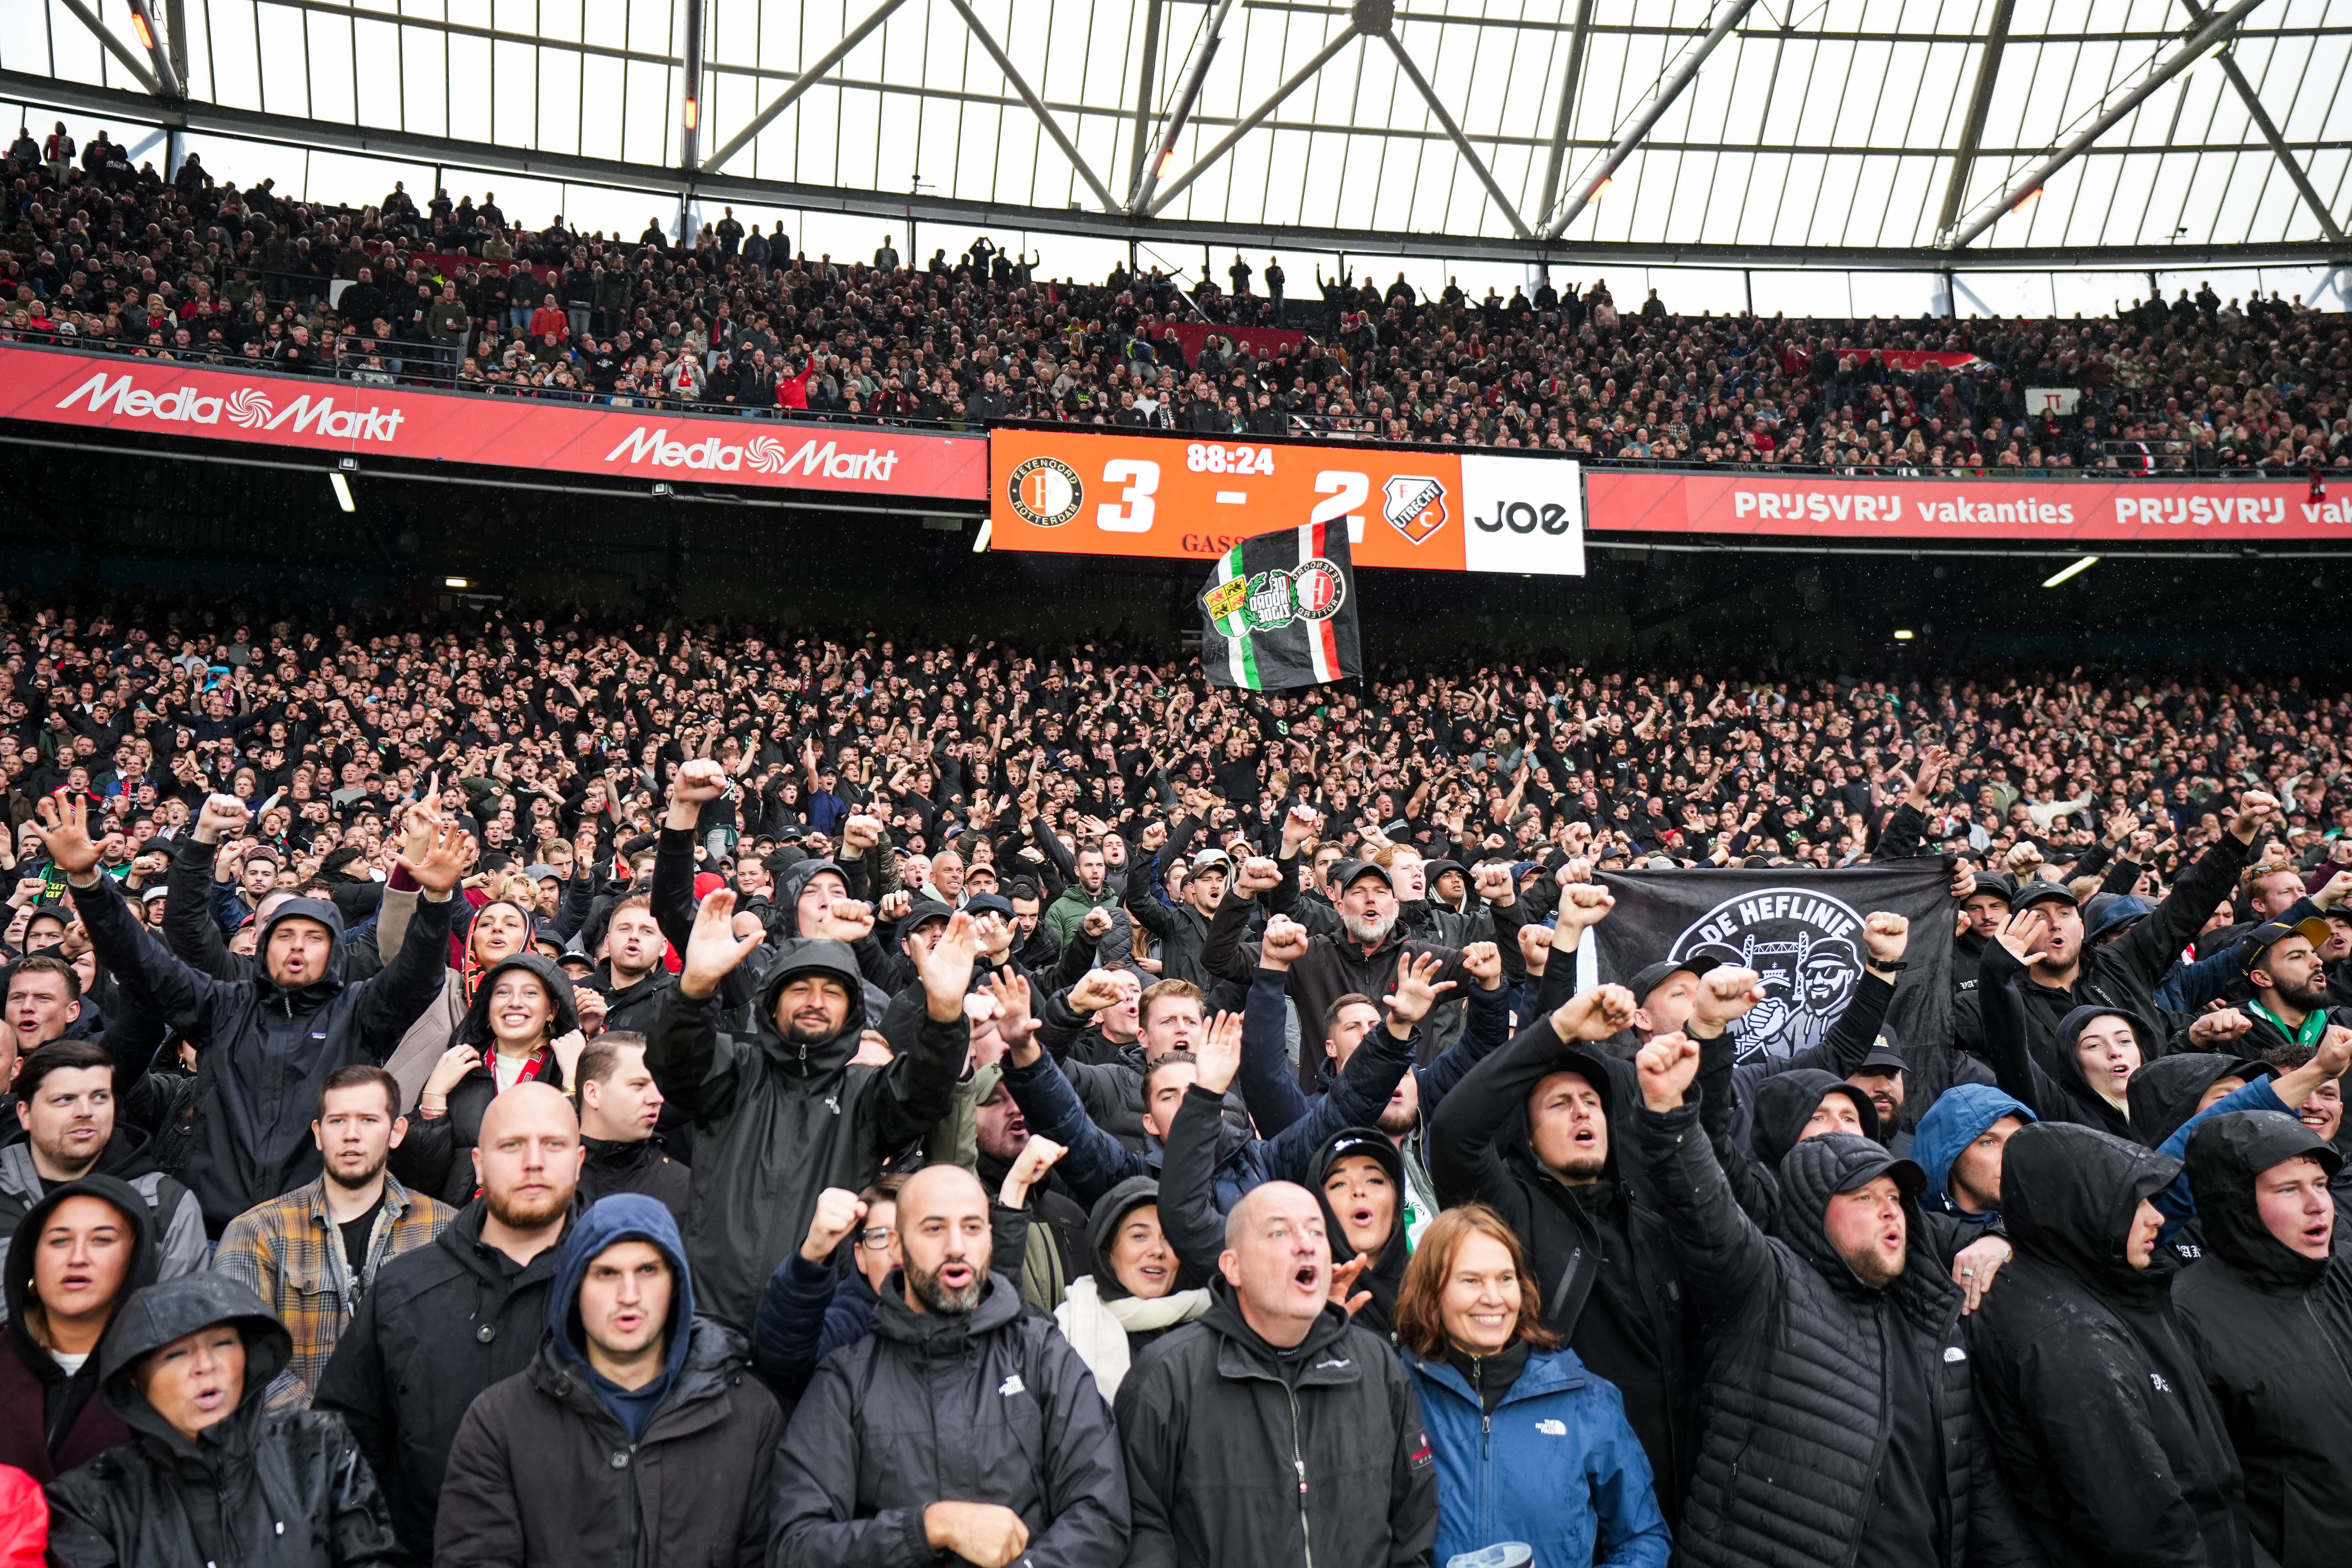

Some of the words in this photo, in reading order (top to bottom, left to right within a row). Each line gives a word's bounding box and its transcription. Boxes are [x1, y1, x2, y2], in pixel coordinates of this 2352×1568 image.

[55, 372, 223, 424] Media
[263, 395, 405, 441] Markt
[604, 427, 745, 471] Media
[777, 440, 899, 481] Markt
[1187, 444, 1274, 475] 88:24
[1013, 459, 1078, 485] FEYENOORD
[1096, 459, 1160, 533] 3
[1310, 470, 1369, 543] 2
[1394, 483, 1440, 528] UTRECHT
[1399, 485, 1408, 499] F
[1013, 500, 1078, 525] ROTTERDAM
[1419, 511, 1434, 527] C
[1916, 496, 2074, 524] vakanties
[1698, 911, 1739, 943] DE
[1738, 895, 1856, 939] HEFLINIE
[1960, 979, 1978, 989] VA
